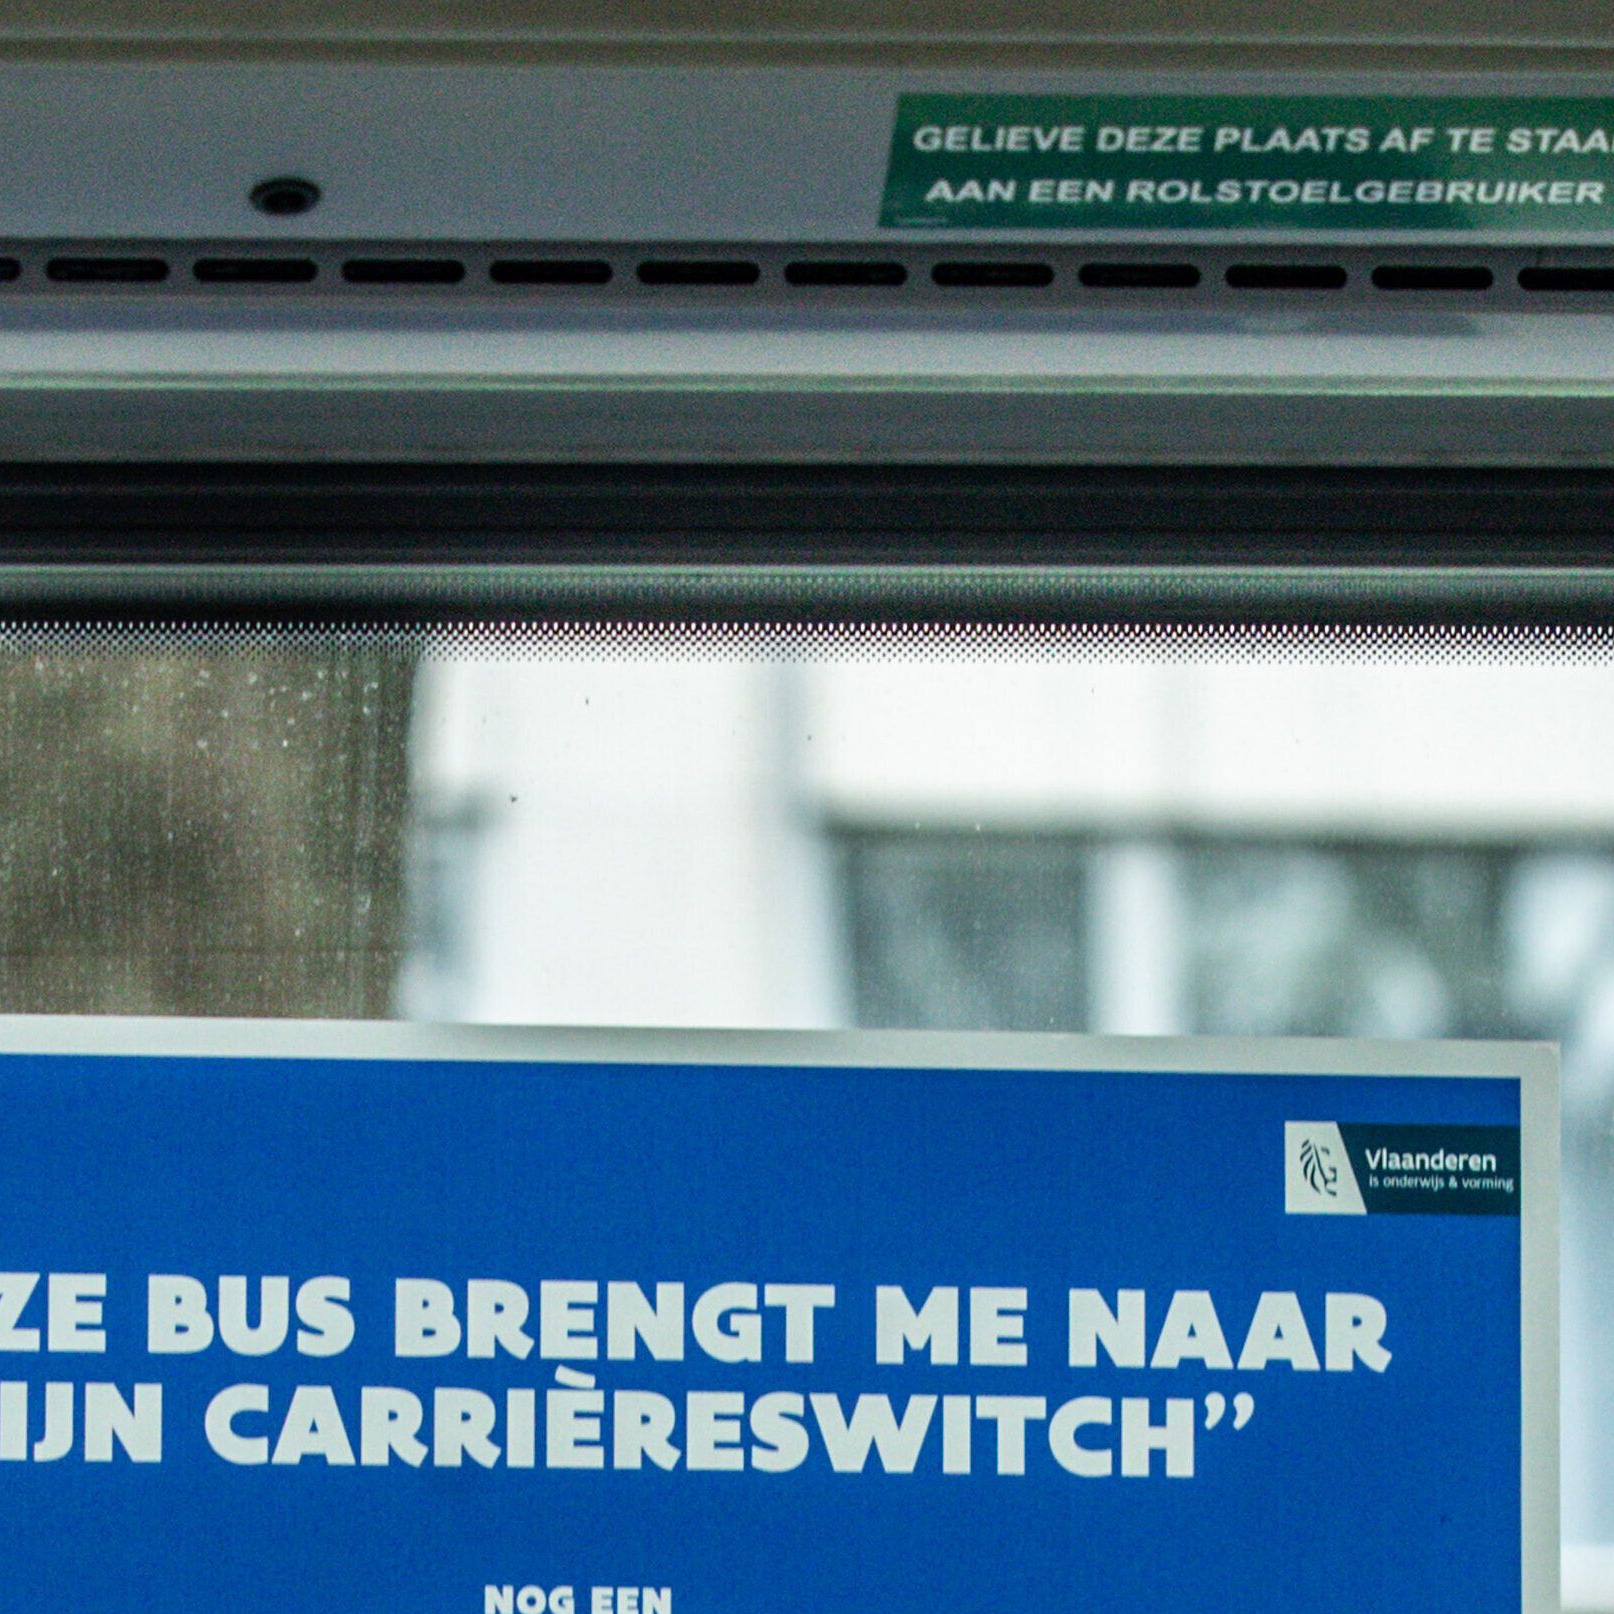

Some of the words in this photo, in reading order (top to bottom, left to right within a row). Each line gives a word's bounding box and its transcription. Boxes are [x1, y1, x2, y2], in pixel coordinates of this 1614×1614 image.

[912, 124, 1085, 153] GELIEVE
[1095, 125, 1203, 153] DEZE
[1213, 125, 1370, 154] PLAATS
[1378, 126, 1435, 154] AF
[1446, 126, 1497, 154] TE
[924, 179, 1016, 204] AAN
[1027, 179, 1115, 204] EEN
[1125, 179, 1608, 206] ROLSTOELGEBRUIKER
[1364, 1147, 1497, 1172] Vlaanderen
[1382, 1174, 1445, 1192] onderwijs
[1448, 1175, 1459, 1189] &
[1461, 1176, 1515, 1194] vorming
[146, 1273, 357, 1358] BUS
[393, 1277, 837, 1364] BRENGT
[874, 1284, 1029, 1367] ME
[1067, 1287, 1393, 1374] NAAR
